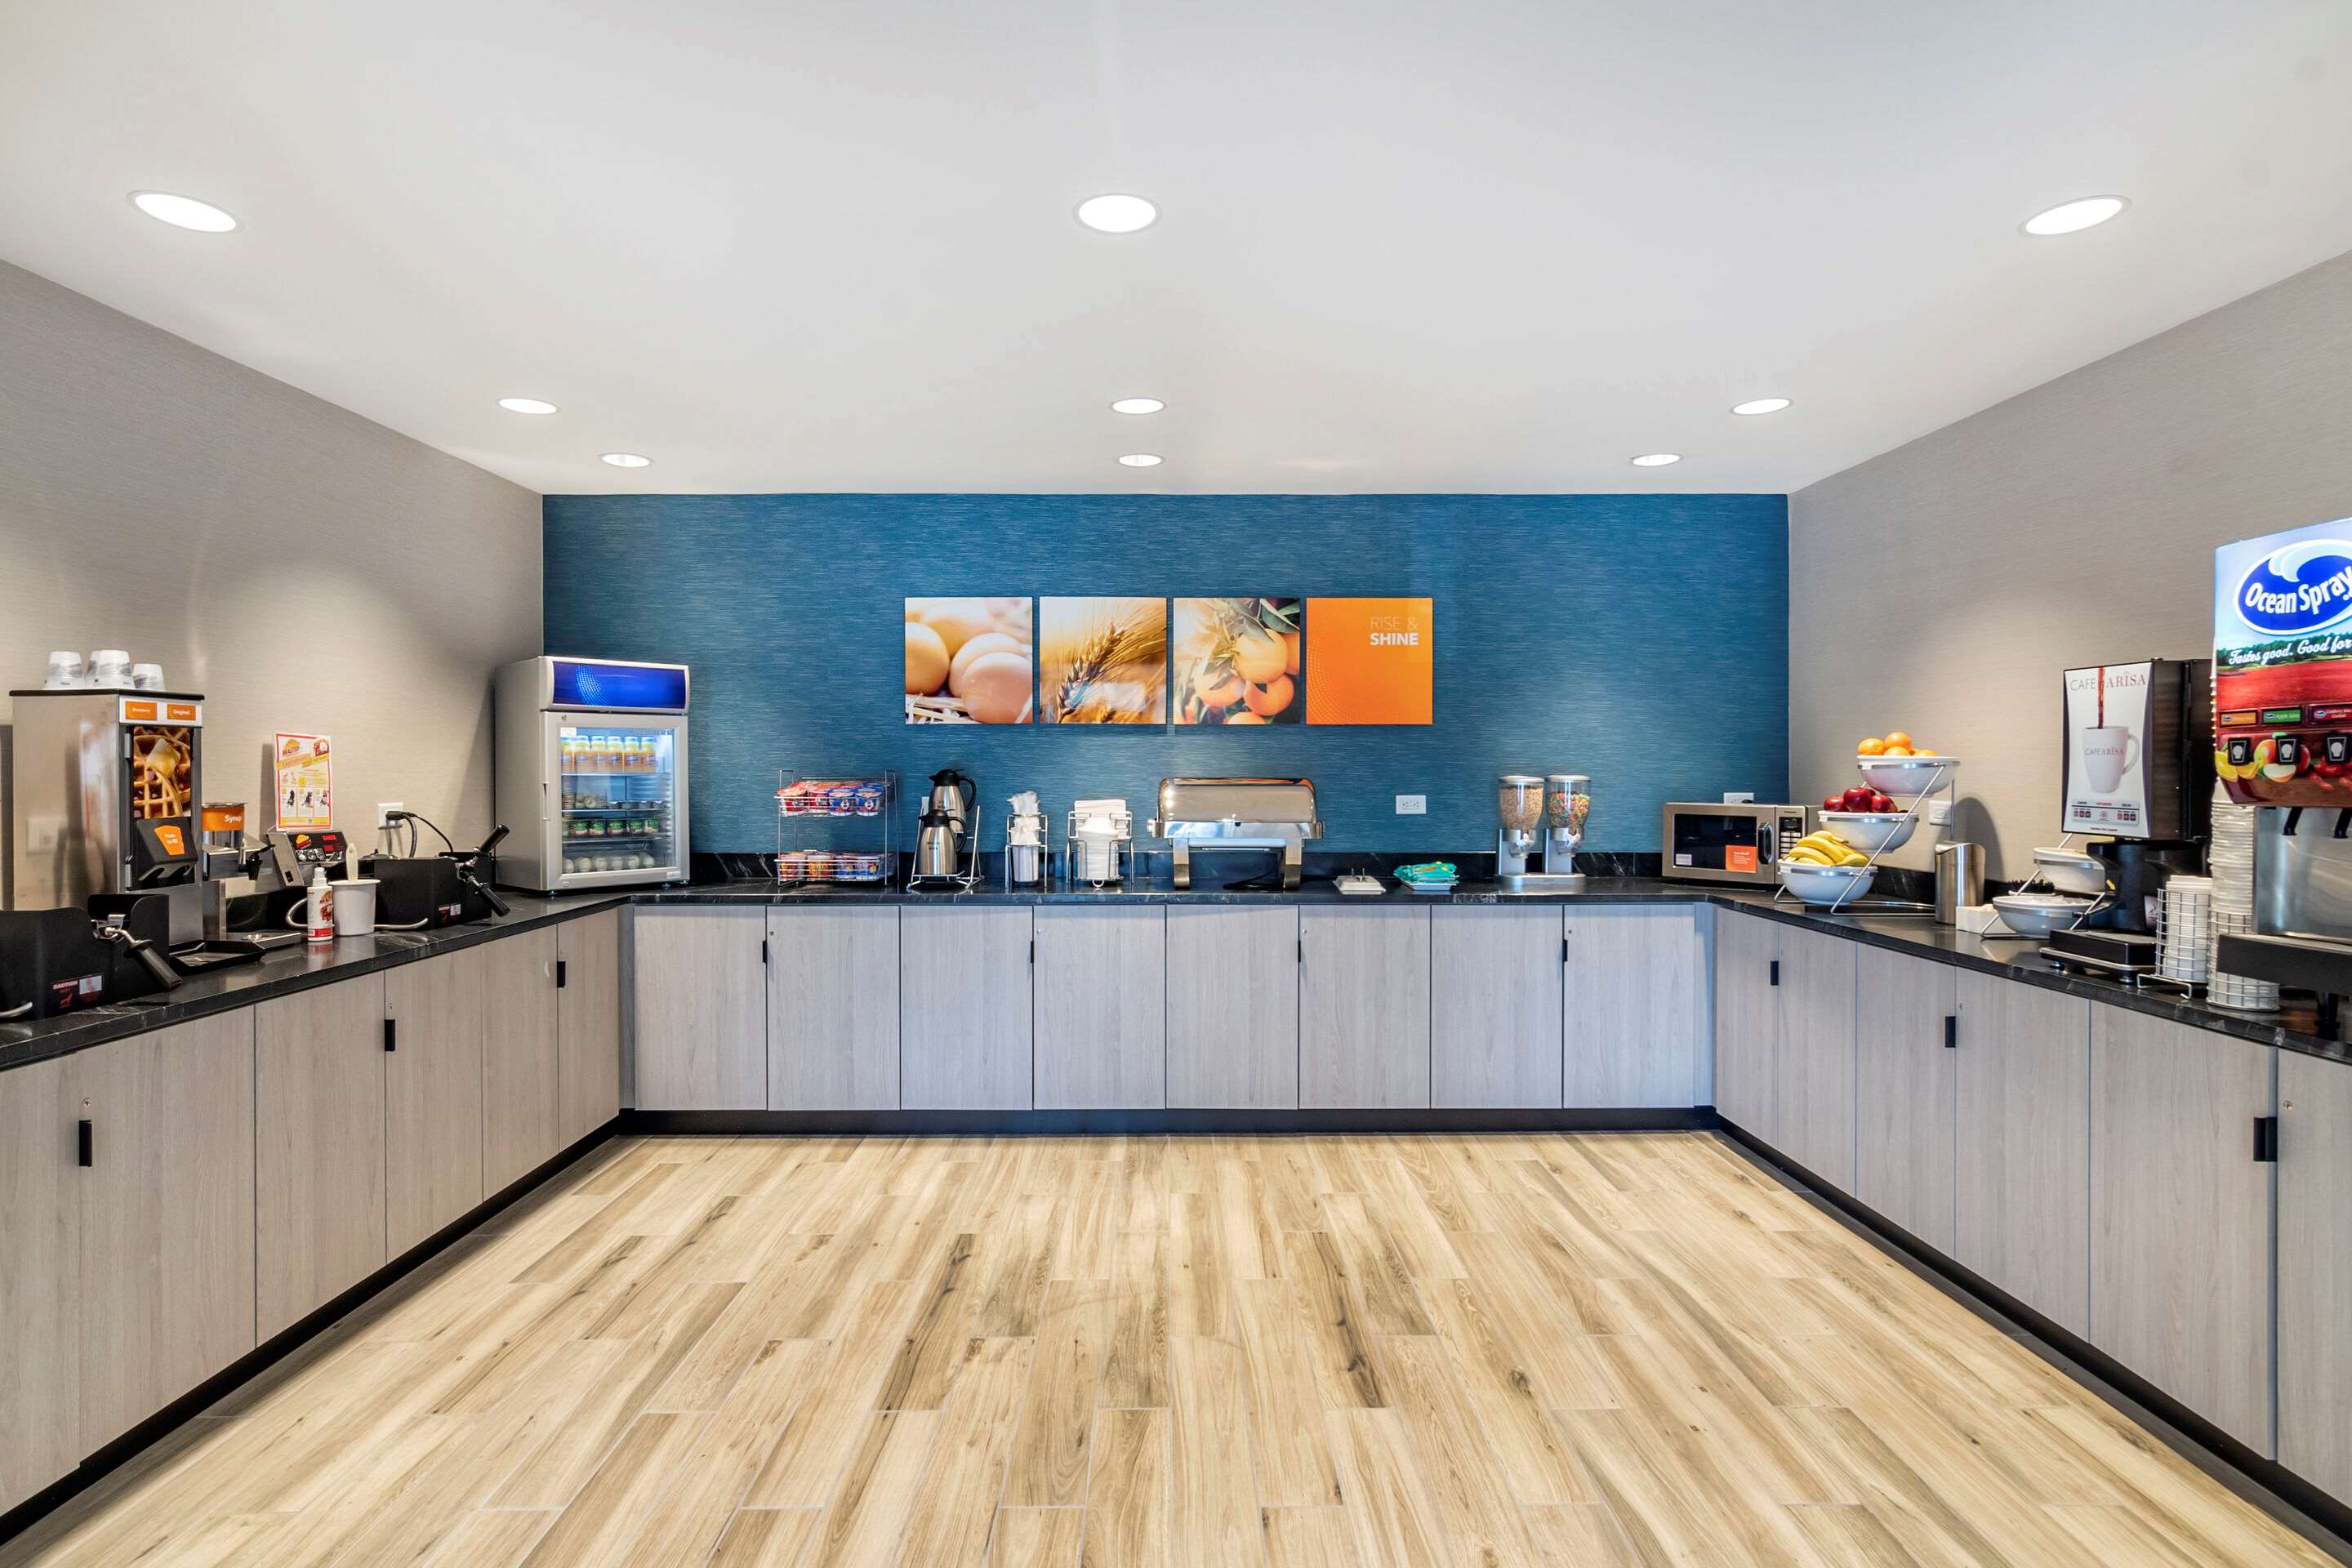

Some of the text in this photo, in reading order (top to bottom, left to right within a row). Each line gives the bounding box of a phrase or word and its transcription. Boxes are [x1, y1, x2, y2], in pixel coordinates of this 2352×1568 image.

[2245, 566, 2352, 615] Ocean Spray
[1370, 617, 1419, 630] RISE &
[1370, 632, 1419, 646] SHINE
[2229, 635, 2352, 666] Tastes good. Good for
[2070, 678, 2096, 691] CAFE
[224, 815, 243, 823] Syrup
